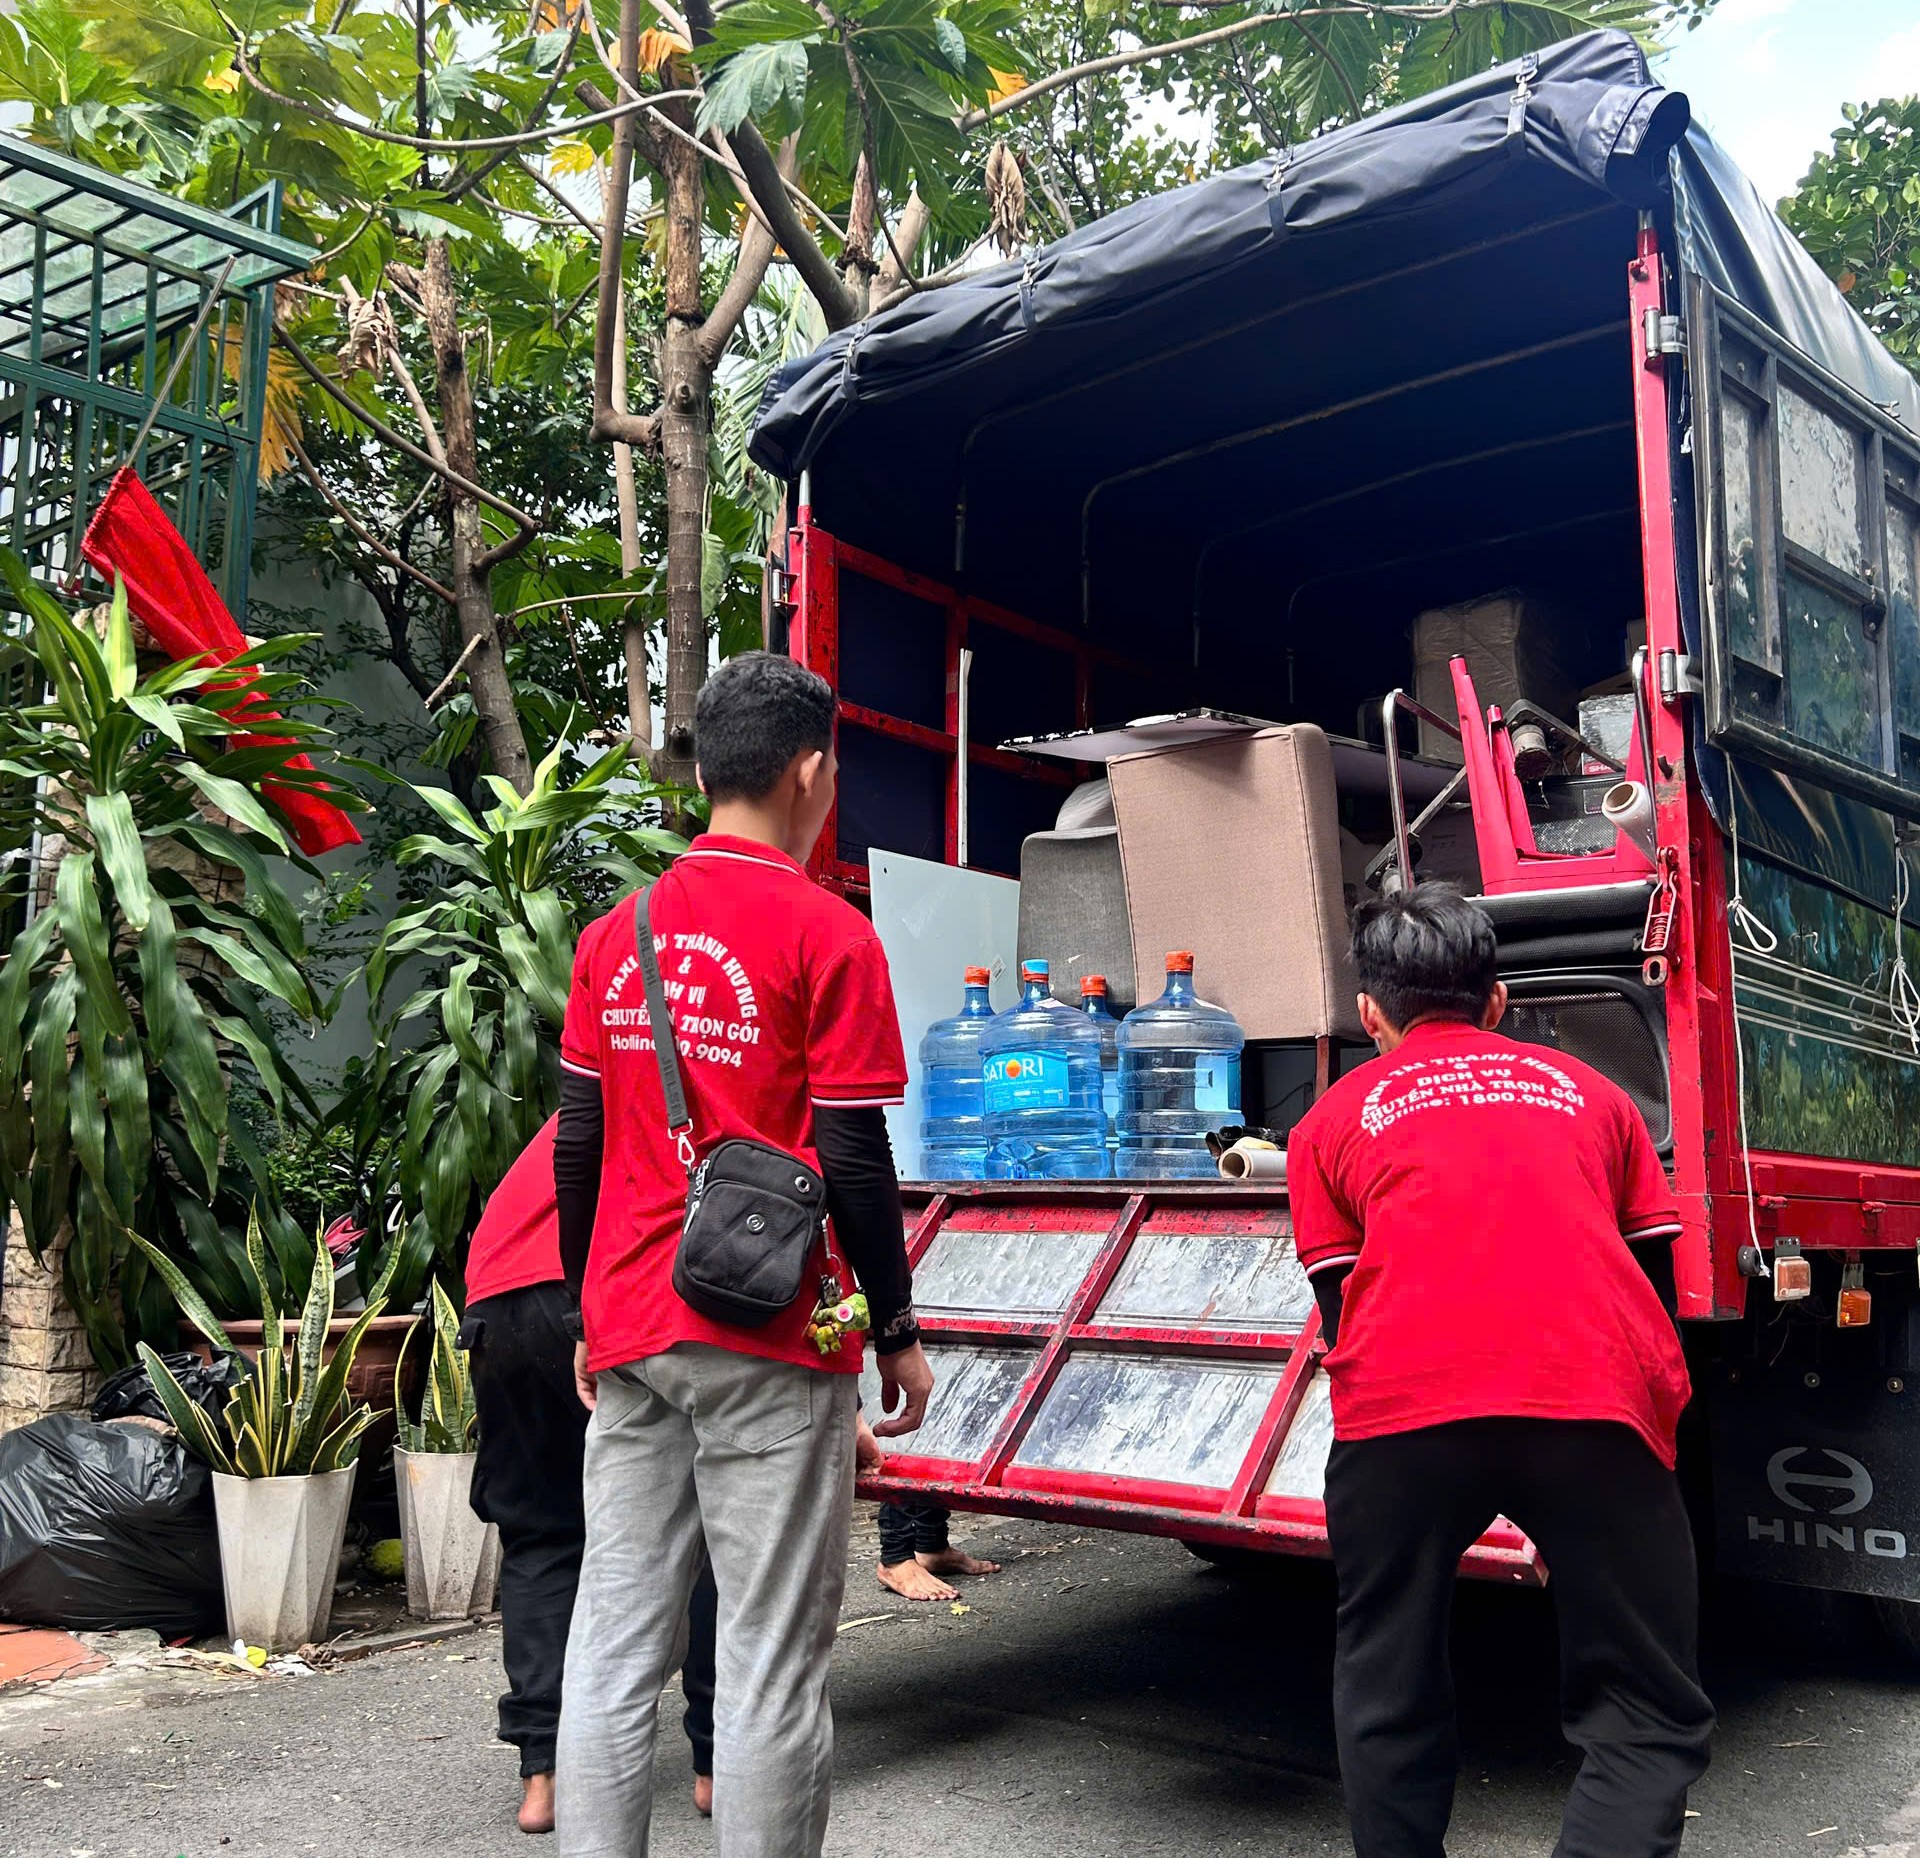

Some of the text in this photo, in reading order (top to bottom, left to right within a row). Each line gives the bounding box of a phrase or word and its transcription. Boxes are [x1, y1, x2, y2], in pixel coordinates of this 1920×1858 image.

[677, 955, 692, 974] &
[605, 954, 639, 1002] TAXI
[688, 986, 707, 1009] VỤ
[602, 998, 651, 1027] CHUYỂ
[680, 1014, 725, 1039] TRỌN
[727, 1020, 761, 1045] GÓI
[983, 1057, 1044, 1083] SATORI
[1416, 1068, 1512, 1087] DỊCH VỤ
[1440, 1080, 1485, 1094] NHÀ
[1489, 1080, 1546, 1094] TRỌN
[1550, 1087, 1585, 1107] GÓI
[1458, 1092, 1576, 1117] 1800.9094
[1747, 1514, 1907, 1560] HINO
